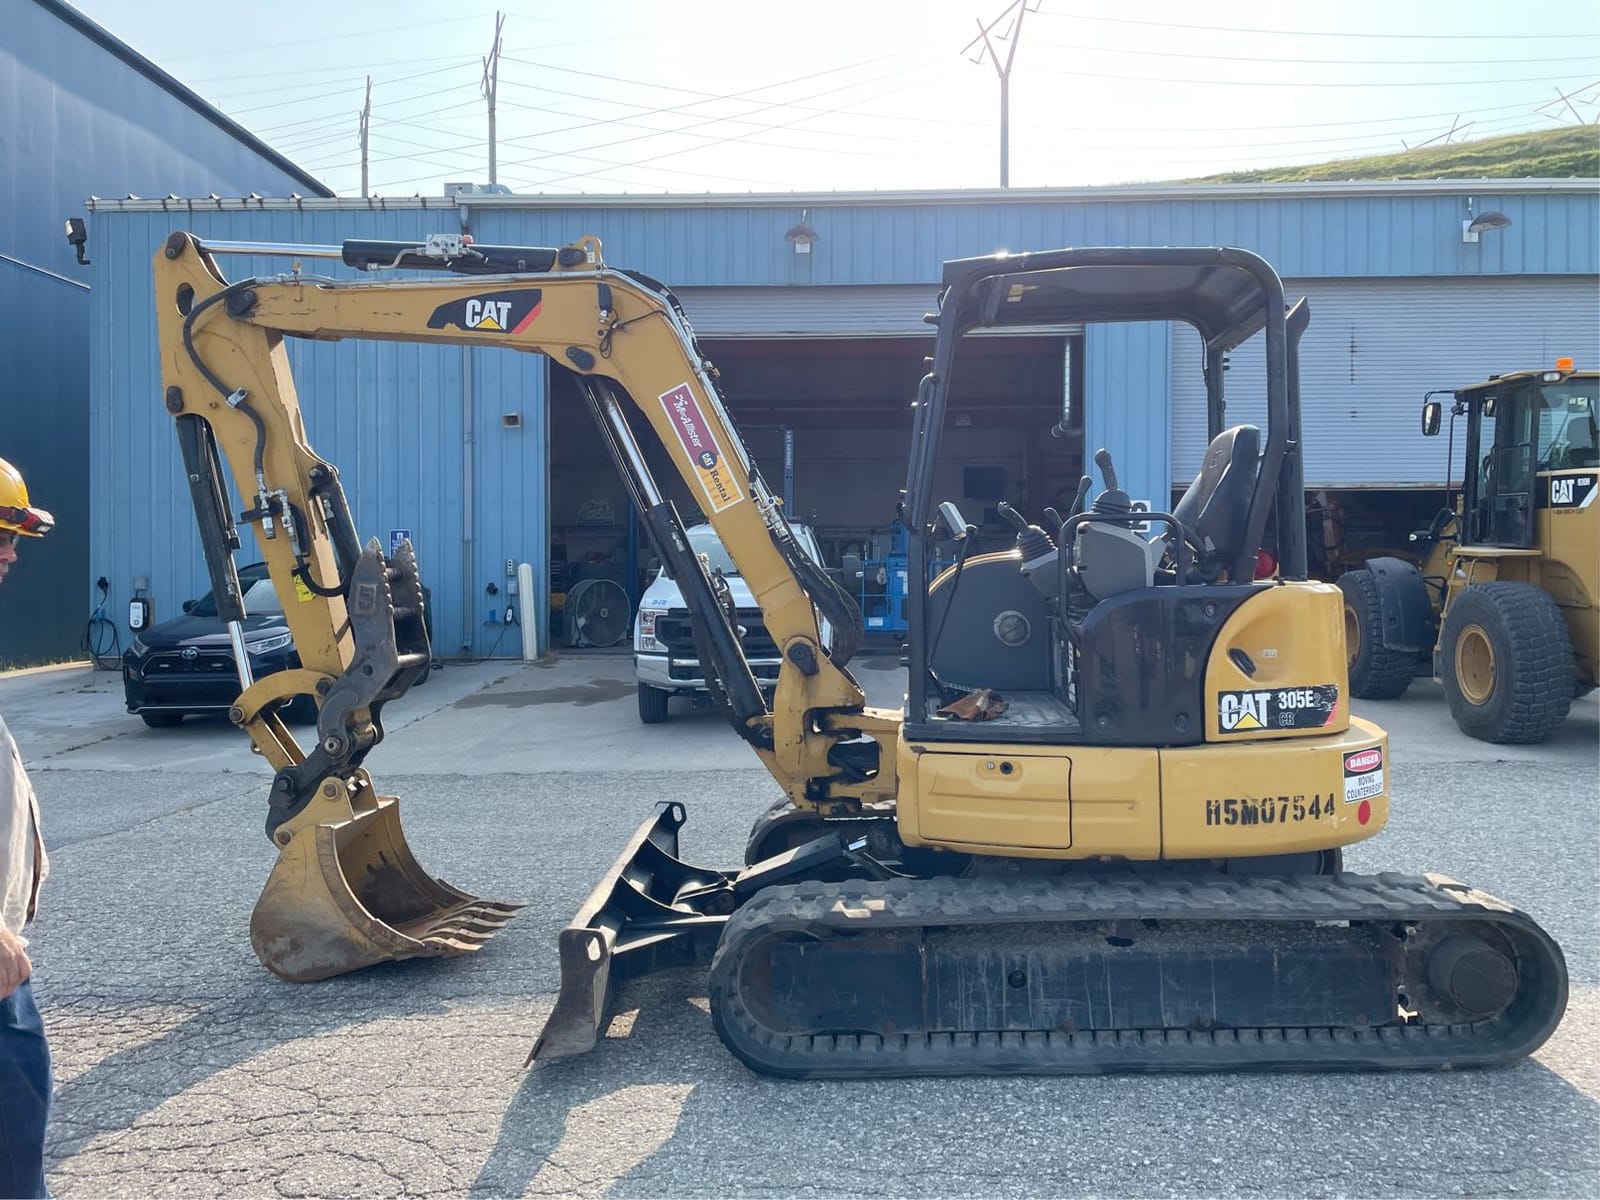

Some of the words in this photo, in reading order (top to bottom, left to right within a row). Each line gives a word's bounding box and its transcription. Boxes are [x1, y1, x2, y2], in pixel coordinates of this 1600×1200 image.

[465, 299, 512, 330] CAT
[702, 452, 714, 466] CAT
[710, 469, 730, 502] Rental
[1552, 479, 1575, 503] CAT
[1221, 692, 1271, 730] CAT
[1278, 712, 1295, 726] CR
[1350, 754, 1378, 768] DANGER
[1358, 774, 1375, 787] MOVING
[1206, 793, 1335, 826] H5M07544
